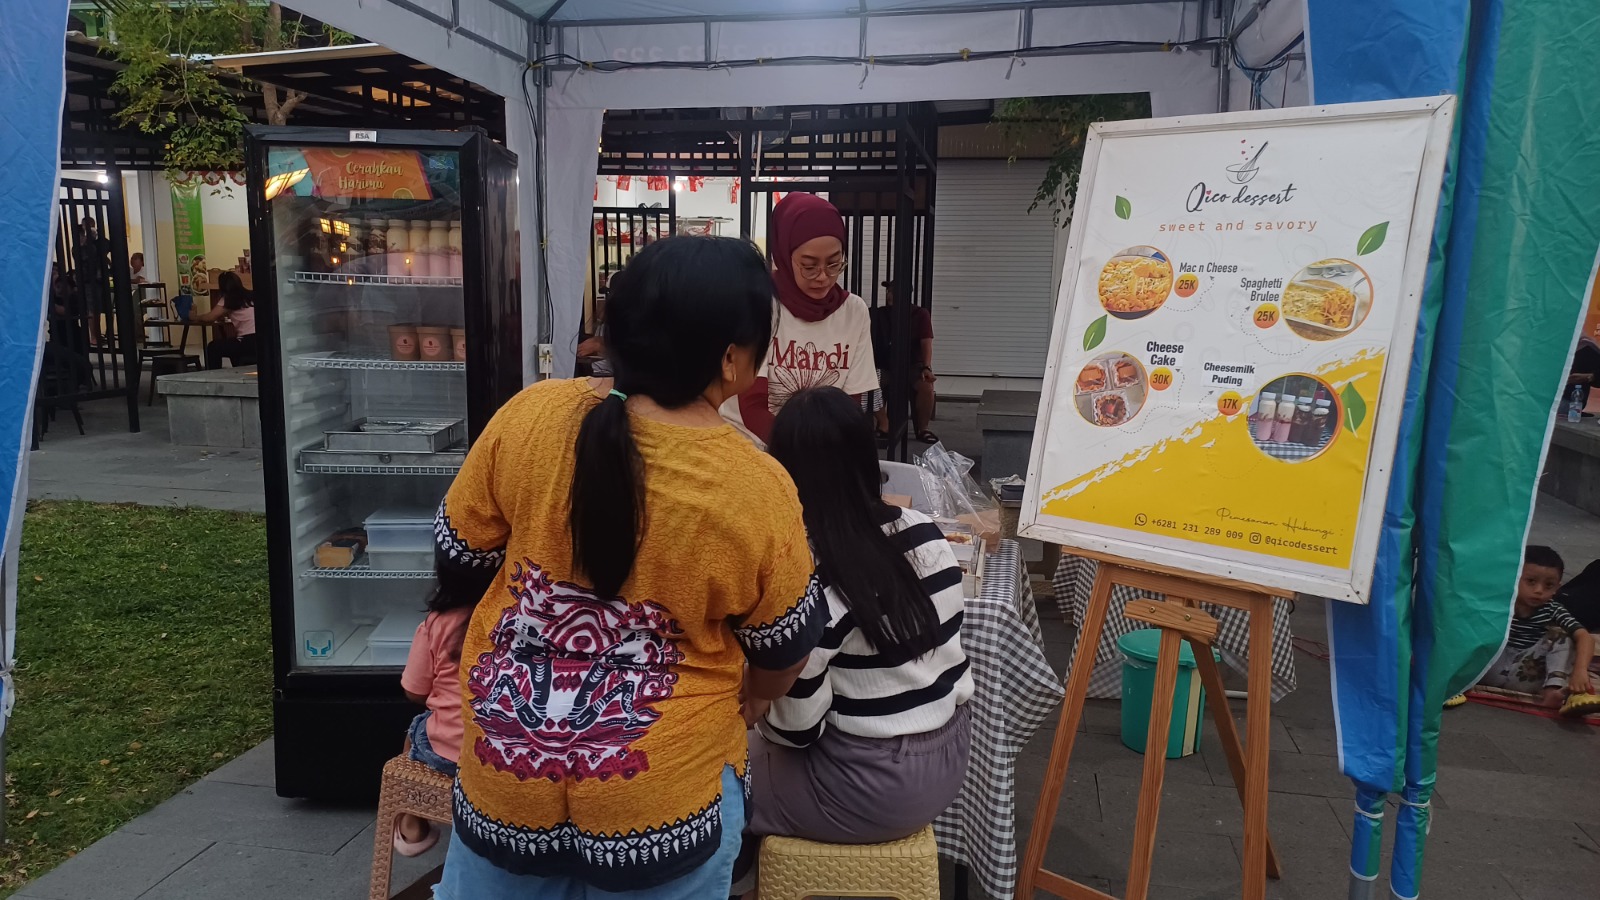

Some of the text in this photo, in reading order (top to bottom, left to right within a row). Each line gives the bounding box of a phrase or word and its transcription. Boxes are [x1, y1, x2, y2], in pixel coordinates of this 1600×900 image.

[355, 132, 370, 140] RSA
[338, 176, 384, 190] Harimu
[1186, 182, 1297, 212] Qico dessert
[1159, 220, 1318, 232] sweet and savory
[1179, 262, 1238, 273] Mac n Cheese
[1178, 279, 1196, 290] 25K
[1240, 277, 1283, 290] Spaghetti
[1250, 291, 1280, 302] Brulee
[1256, 311, 1276, 322] 25K
[1146, 341, 1184, 353] Cheese
[768, 336, 850, 371] Mardi
[1150, 354, 1176, 366] Cake
[1203, 362, 1255, 374] Cheesemilk
[1152, 373, 1170, 385] 30K
[1211, 374, 1243, 386] Puding
[1222, 398, 1239, 410] 17K
[1151, 519, 1244, 540] +6281 231 289 009
[1216, 507, 1278, 526] Pemesanan
[1282, 517, 1335, 540] Hubungi
[1265, 535, 1339, 555] @qicodessert
